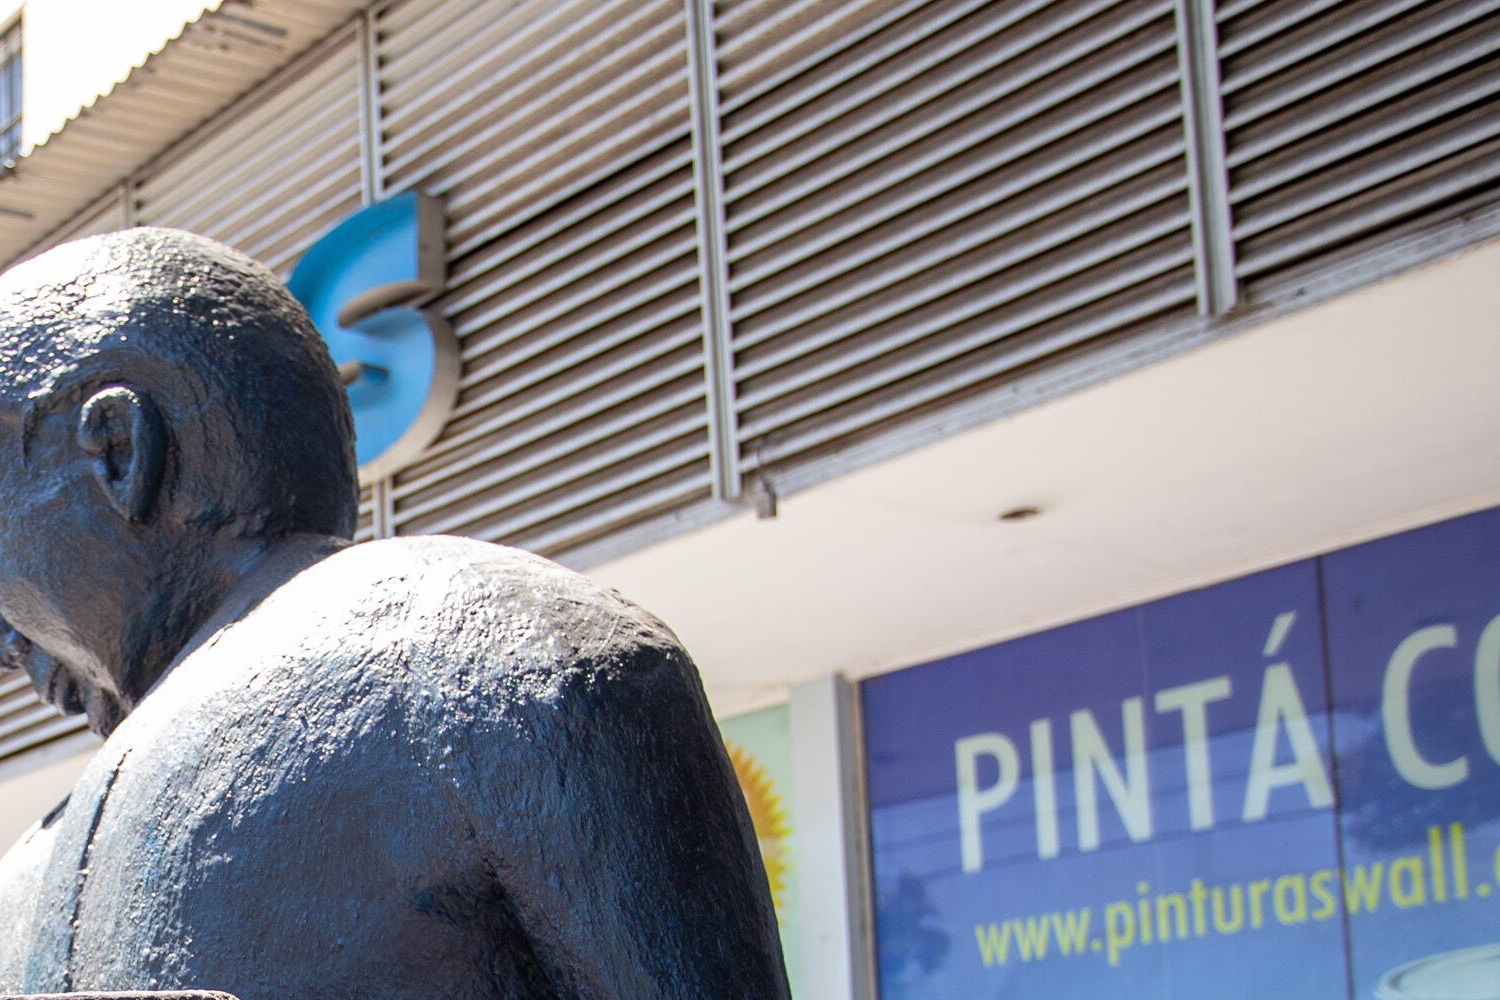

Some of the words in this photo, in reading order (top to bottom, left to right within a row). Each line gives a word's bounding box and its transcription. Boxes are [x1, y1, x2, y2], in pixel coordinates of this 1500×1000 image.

[955, 610, 1336, 874] PINTÁ
[1382, 612, 1500, 790] C
[975, 821, 1500, 968] www.pinturaswall.
